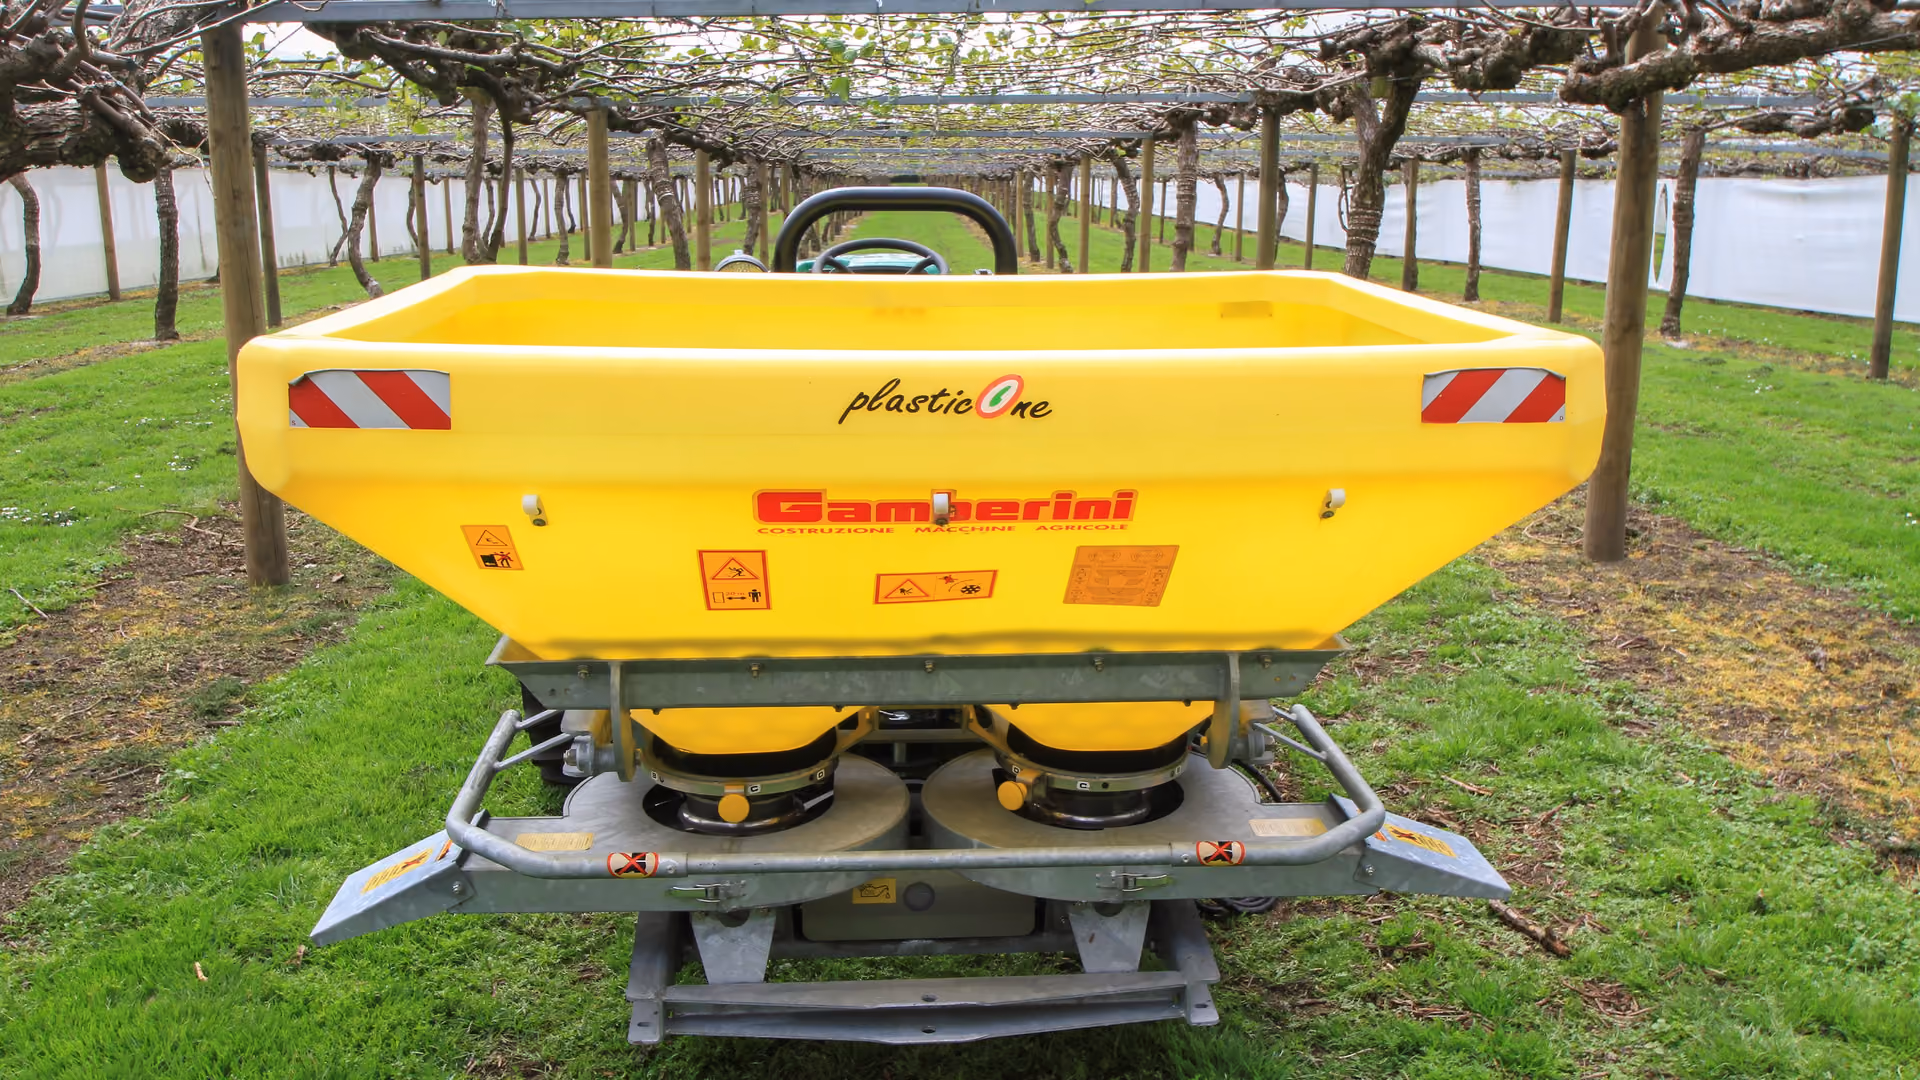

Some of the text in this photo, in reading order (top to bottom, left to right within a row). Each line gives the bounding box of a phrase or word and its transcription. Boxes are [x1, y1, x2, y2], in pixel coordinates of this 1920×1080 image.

[757, 524, 1129, 535] COSTRUZIONE MACCHINE AGRICOLE
